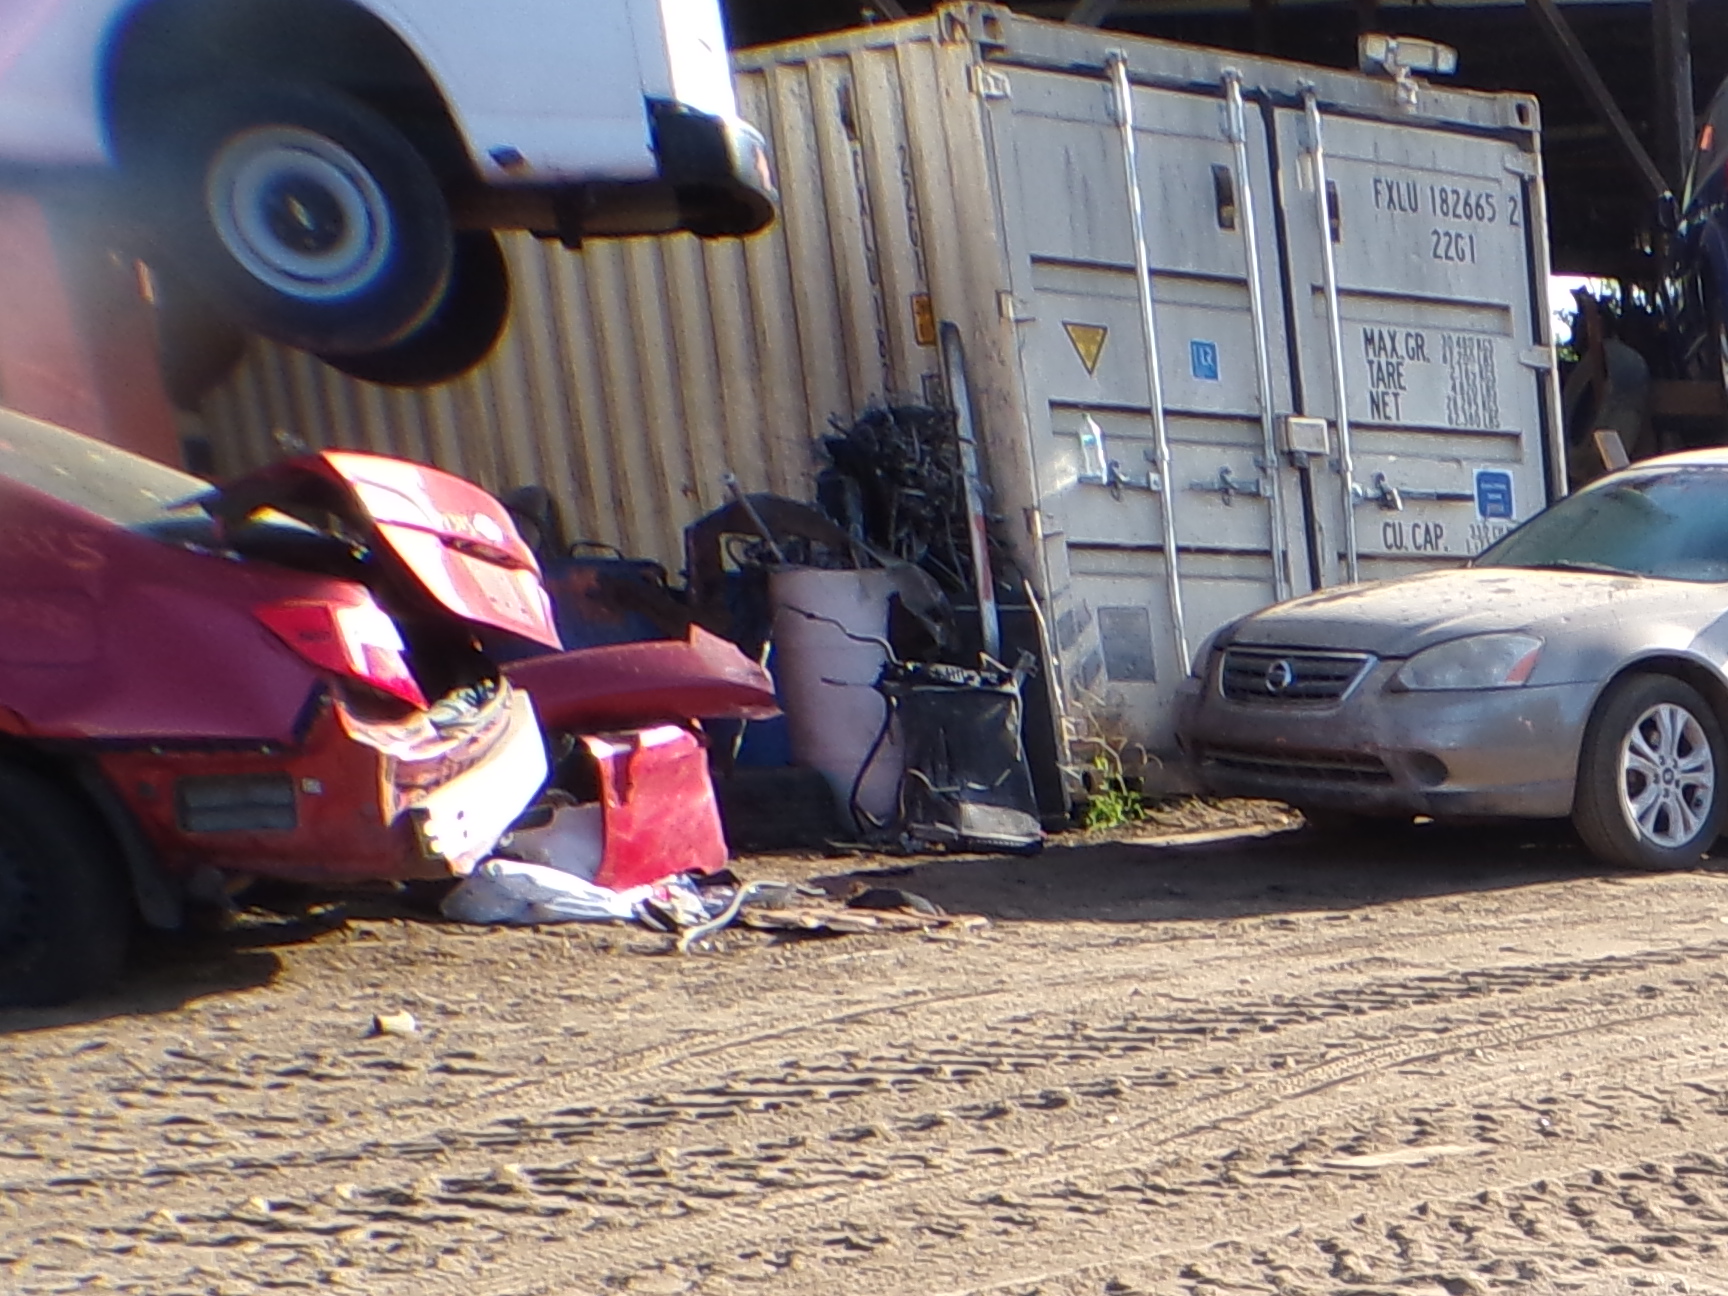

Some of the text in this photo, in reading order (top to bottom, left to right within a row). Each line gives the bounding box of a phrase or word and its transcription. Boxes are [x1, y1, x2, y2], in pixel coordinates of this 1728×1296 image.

[1373, 178, 1521, 227] FXLU 182665 2
[1431, 228, 1476, 264] 22G1
[1366, 359, 1407, 391] TARE
[1369, 390, 1401, 421] NET
[1411, 522, 1449, 552] CAP.
